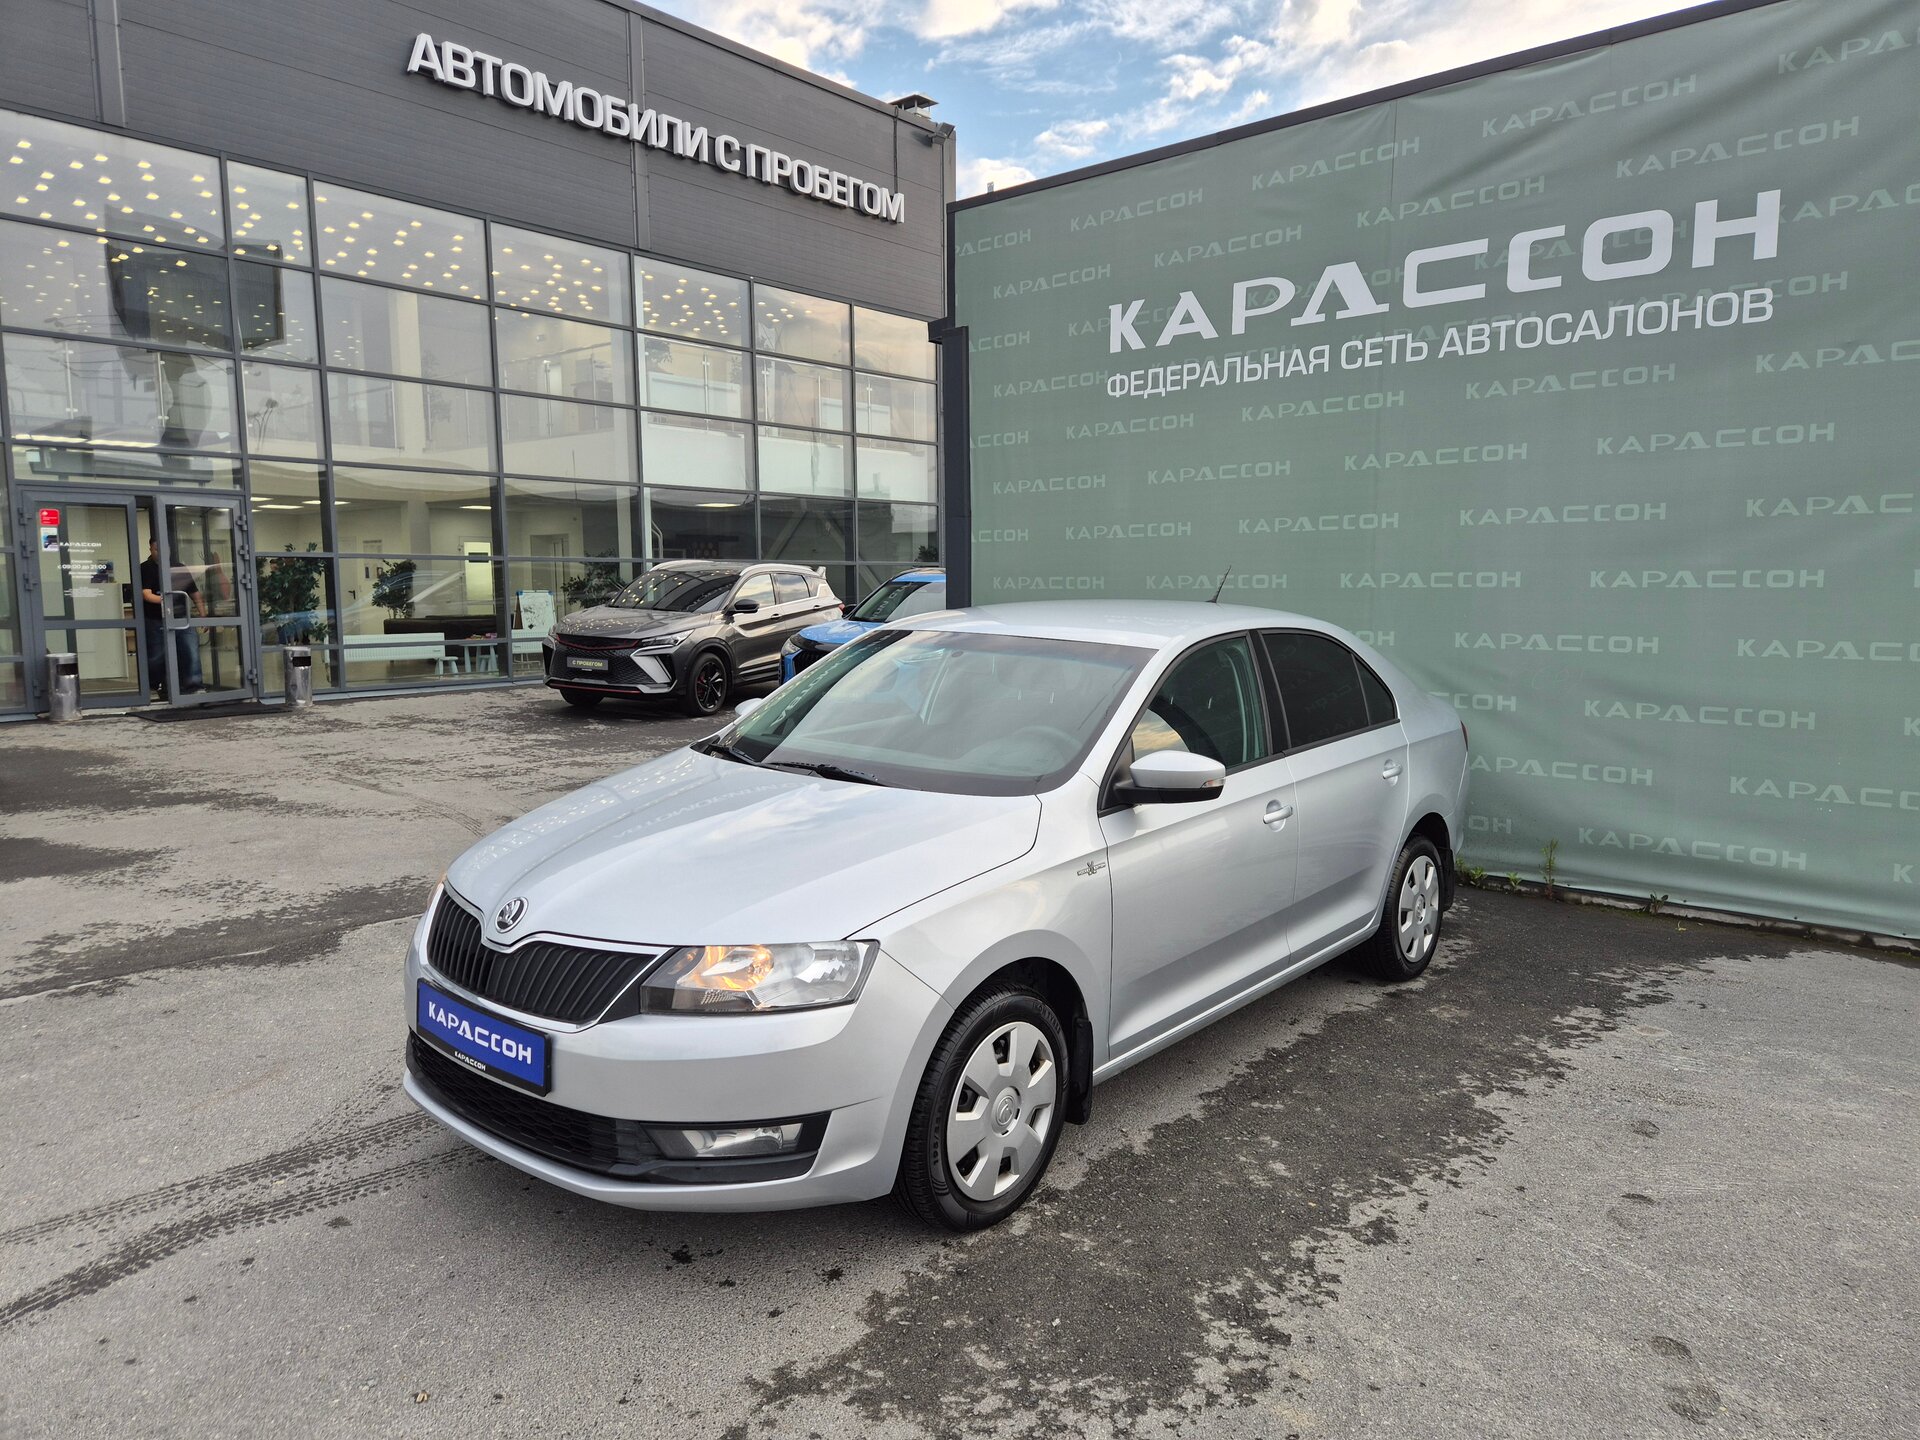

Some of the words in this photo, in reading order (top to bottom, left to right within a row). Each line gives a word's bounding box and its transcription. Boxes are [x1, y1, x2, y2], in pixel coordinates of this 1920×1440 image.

[1778, 28, 1920, 74] КАРА
[1482, 74, 1697, 138] КАРАССОН
[407, 33, 708, 163] АВТОМОБИЛИ
[715, 135, 740, 172] С
[746, 143, 904, 223] ПРОБЕГОМ
[1616, 116, 1859, 178] КАРАССОН
[1252, 137, 1420, 190] КАРАССОН
[1071, 188, 1203, 231] КАРАССОН
[1357, 176, 1545, 228] КАРАССОН
[1154, 225, 1301, 267] КАРАССОН
[993, 264, 1110, 299] КАРАССОН
[1109, 189, 1780, 353] КАРАССОН
[1107, 345, 1329, 399] ФЕДЕРАЛЬНАЯ
[1341, 334, 1428, 369] СЕТЬ
[1438, 288, 1774, 358] АВТОСАЛОНОВ
[993, 371, 1108, 397] КАРАССОН
[1465, 363, 1675, 399] КАРАССОН
[1241, 391, 1404, 422] КАРАССОН
[970, 431, 1029, 448] ССОН
[1066, 413, 1194, 440] КАРАССОН
[1597, 422, 1834, 455] КАРАССОН
[1344, 443, 1527, 470] КАРАССОН
[993, 474, 1105, 494] КАРАССОН
[1148, 460, 1291, 484] КАРАССОН
[1238, 513, 1399, 534] КАРАССОН
[1460, 502, 1666, 526] КАРАССОН
[971, 529, 1028, 542] ССОН
[1065, 521, 1191, 541] КАРАССОН
[993, 576, 1104, 589] КАРАССОН
[1146, 573, 1287, 589] КАРАССОН
[1340, 571, 1521, 588] КАРАССОН
[1590, 569, 1824, 588] КАРАССОН
[1454, 632, 1659, 654] КАРАССОН
[1584, 700, 1815, 730] КАРАССОН
[1578, 827, 1807, 870] КАРАССОН
[428, 1001, 532, 1065] КАРАССОН
[454, 1051, 486, 1071] КАРАССОН
